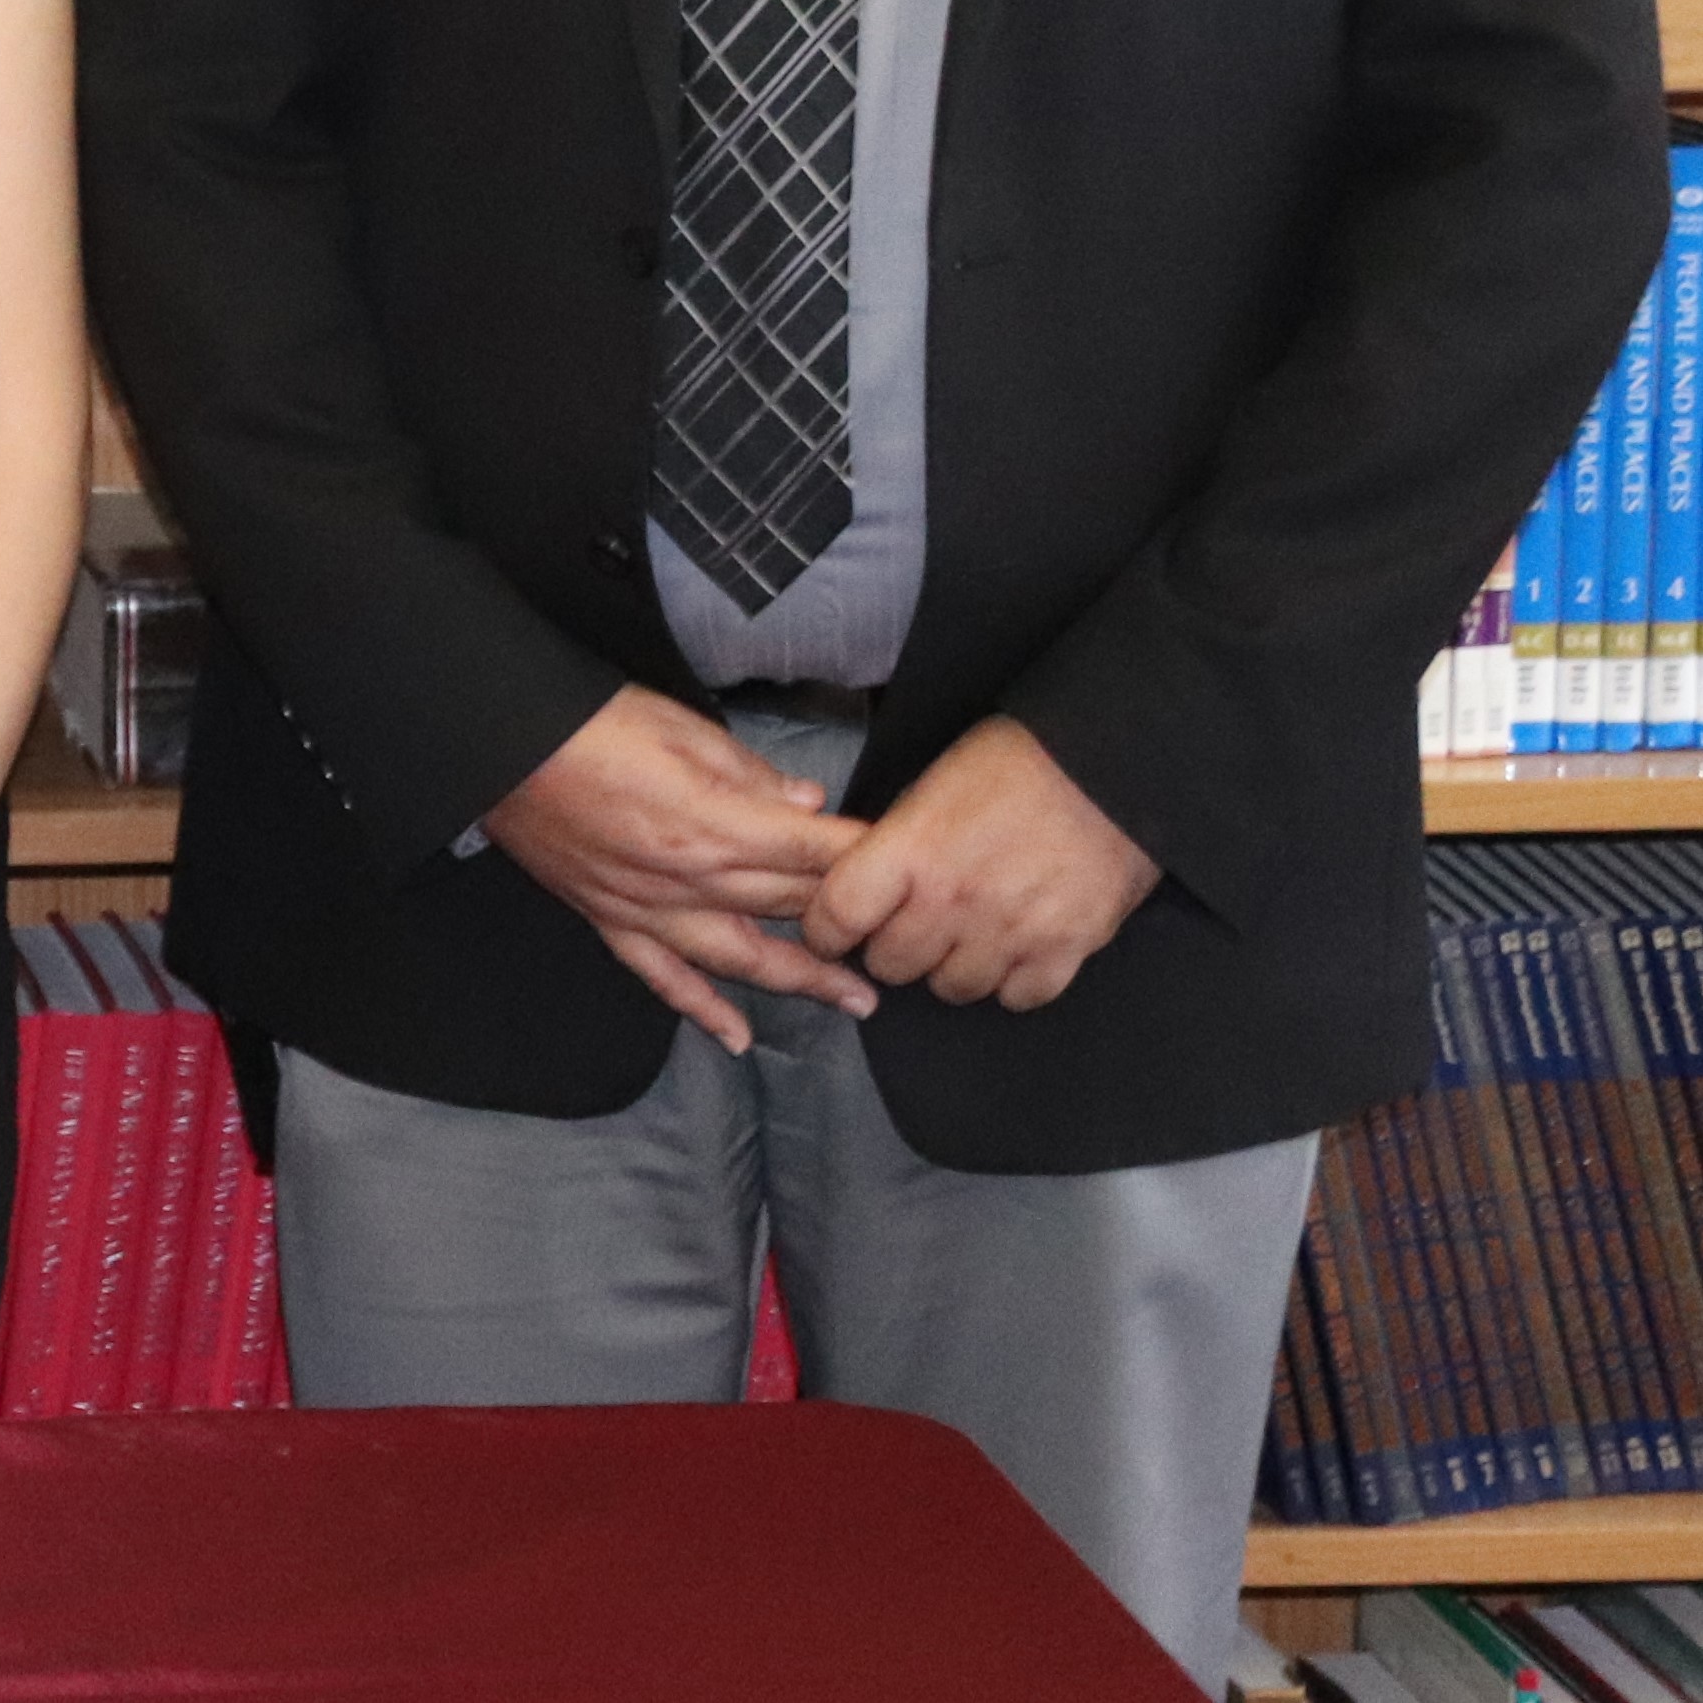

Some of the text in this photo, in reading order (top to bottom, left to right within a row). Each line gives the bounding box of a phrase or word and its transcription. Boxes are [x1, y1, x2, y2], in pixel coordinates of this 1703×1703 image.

[1675, 252, 1701, 343] PEOPLE
[1625, 357, 1650, 415] AND
[1672, 355, 1697, 414] AND
[1575, 419, 1601, 514] PLACES
[1621, 419, 1648, 513] PLACES
[1666, 418, 1694, 513] PLACES
[1527, 577, 1542, 602] 1
[1575, 577, 1594, 604] 2
[1621, 577, 1640, 604] 3
[1666, 575, 1687, 601] 4
